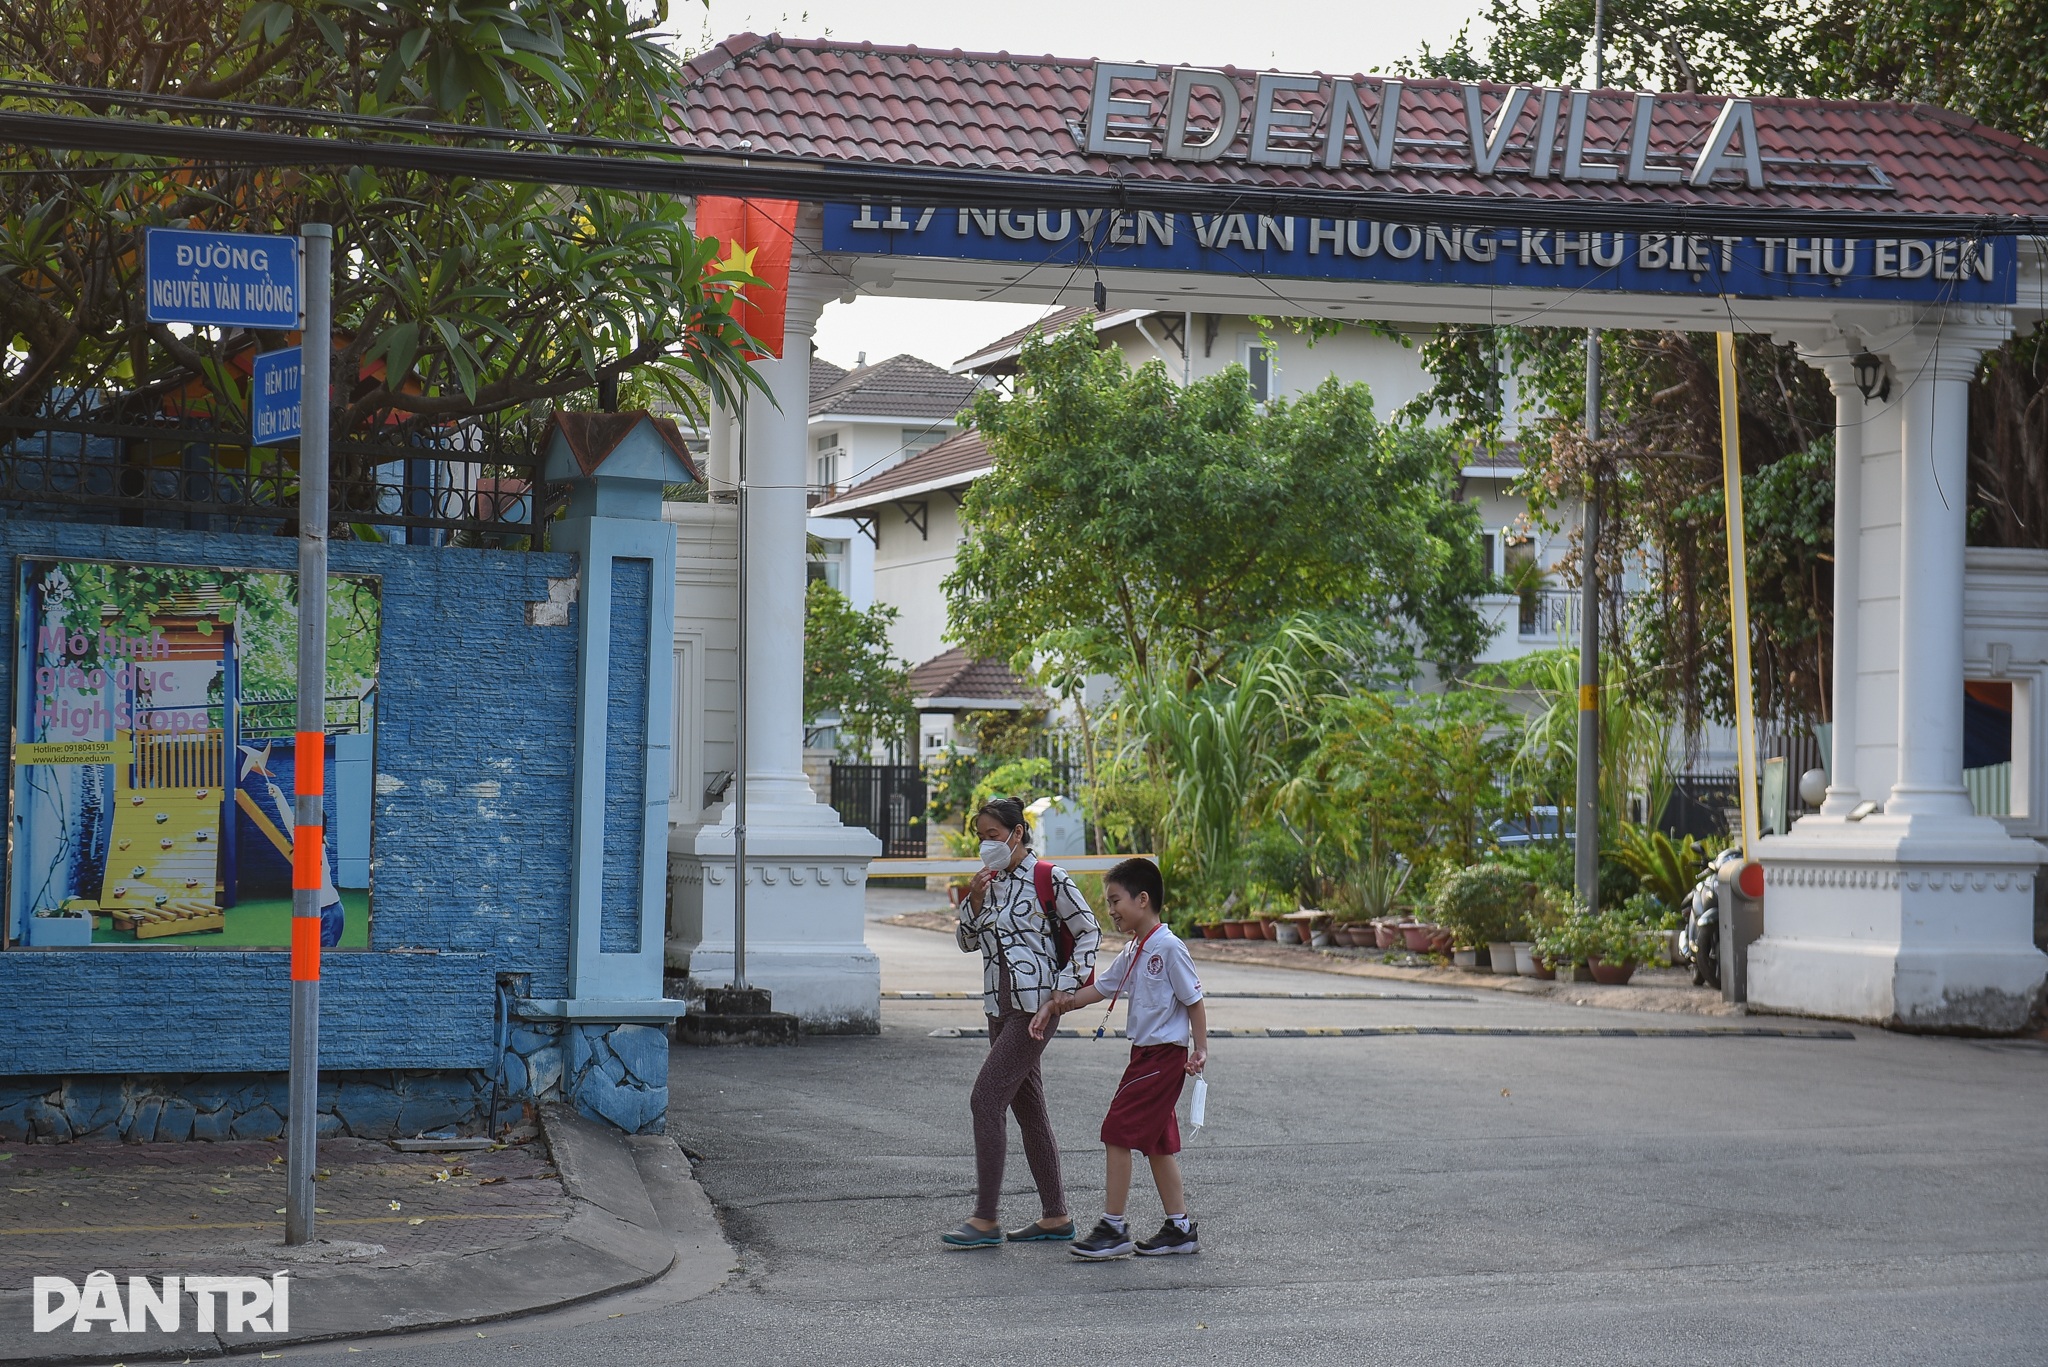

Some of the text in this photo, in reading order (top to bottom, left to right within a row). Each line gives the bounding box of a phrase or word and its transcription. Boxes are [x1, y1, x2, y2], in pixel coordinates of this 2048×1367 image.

[1085, 59, 1767, 190] EDEN VILLA
[176, 241, 269, 272] ĐƯỜNG
[1875, 239, 1995, 281] EDEN
[152, 268, 293, 313] NGUYỄN VĂN HƯỞNG
[265, 363, 298, 396] HẺM 117
[278, 407, 291, 432] 120
[37, 625, 170, 659] Mô hình
[35, 655, 175, 700] giáo dục
[35, 699, 209, 740] HighScope
[32, 755, 111, 764] www.kidzone.edu.vn
[33, 743, 110, 754] Hotline: 0918041591
